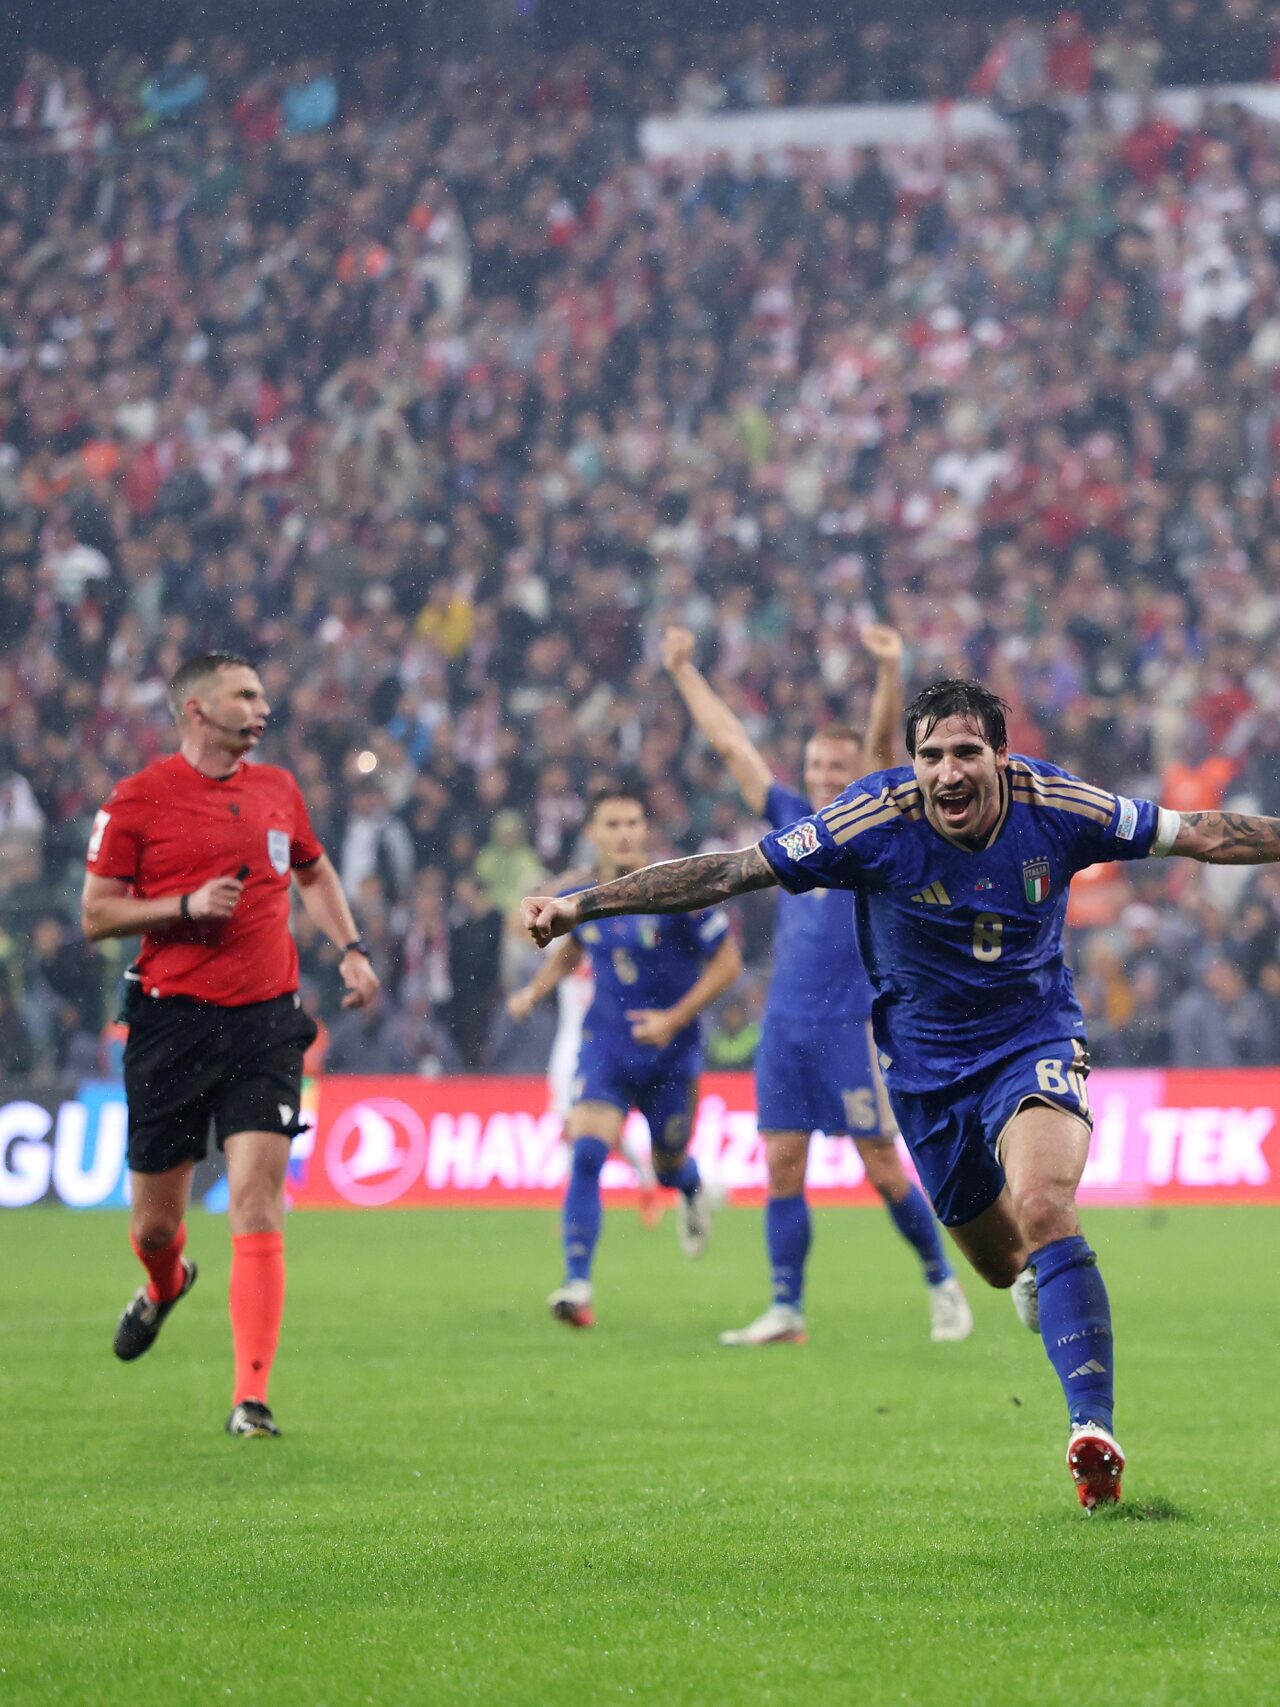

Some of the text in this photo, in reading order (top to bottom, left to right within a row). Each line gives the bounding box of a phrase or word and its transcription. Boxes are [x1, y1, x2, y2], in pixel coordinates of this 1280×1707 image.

[973, 912, 1003, 962] 8
[1036, 1059, 1069, 1095] 8
[1142, 1106, 1276, 1187] TEK
